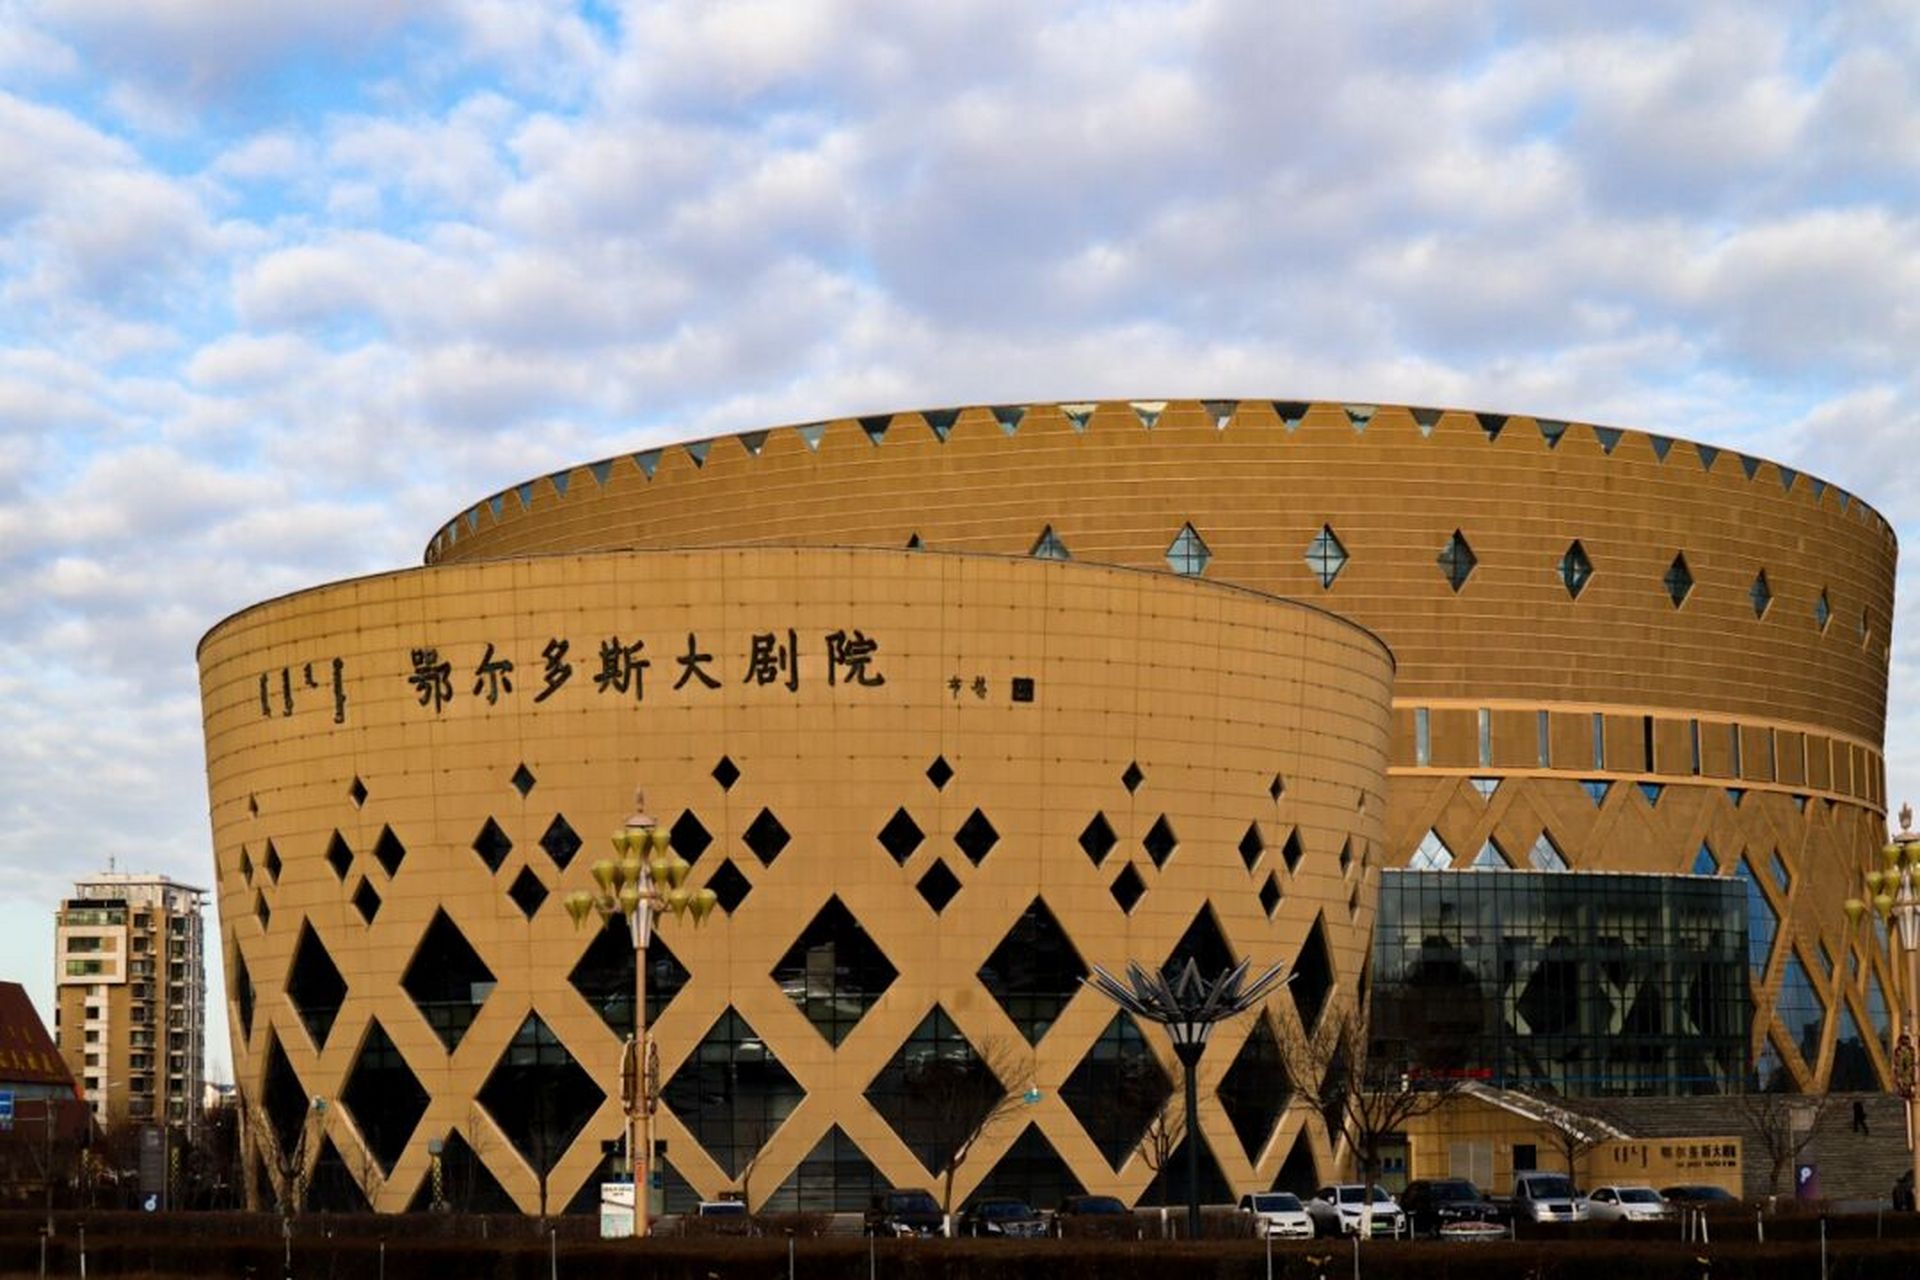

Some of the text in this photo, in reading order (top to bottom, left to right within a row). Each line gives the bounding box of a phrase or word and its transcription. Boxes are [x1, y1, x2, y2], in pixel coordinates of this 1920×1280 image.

[408, 628, 886, 714] 鄂尔多斯大剧院
